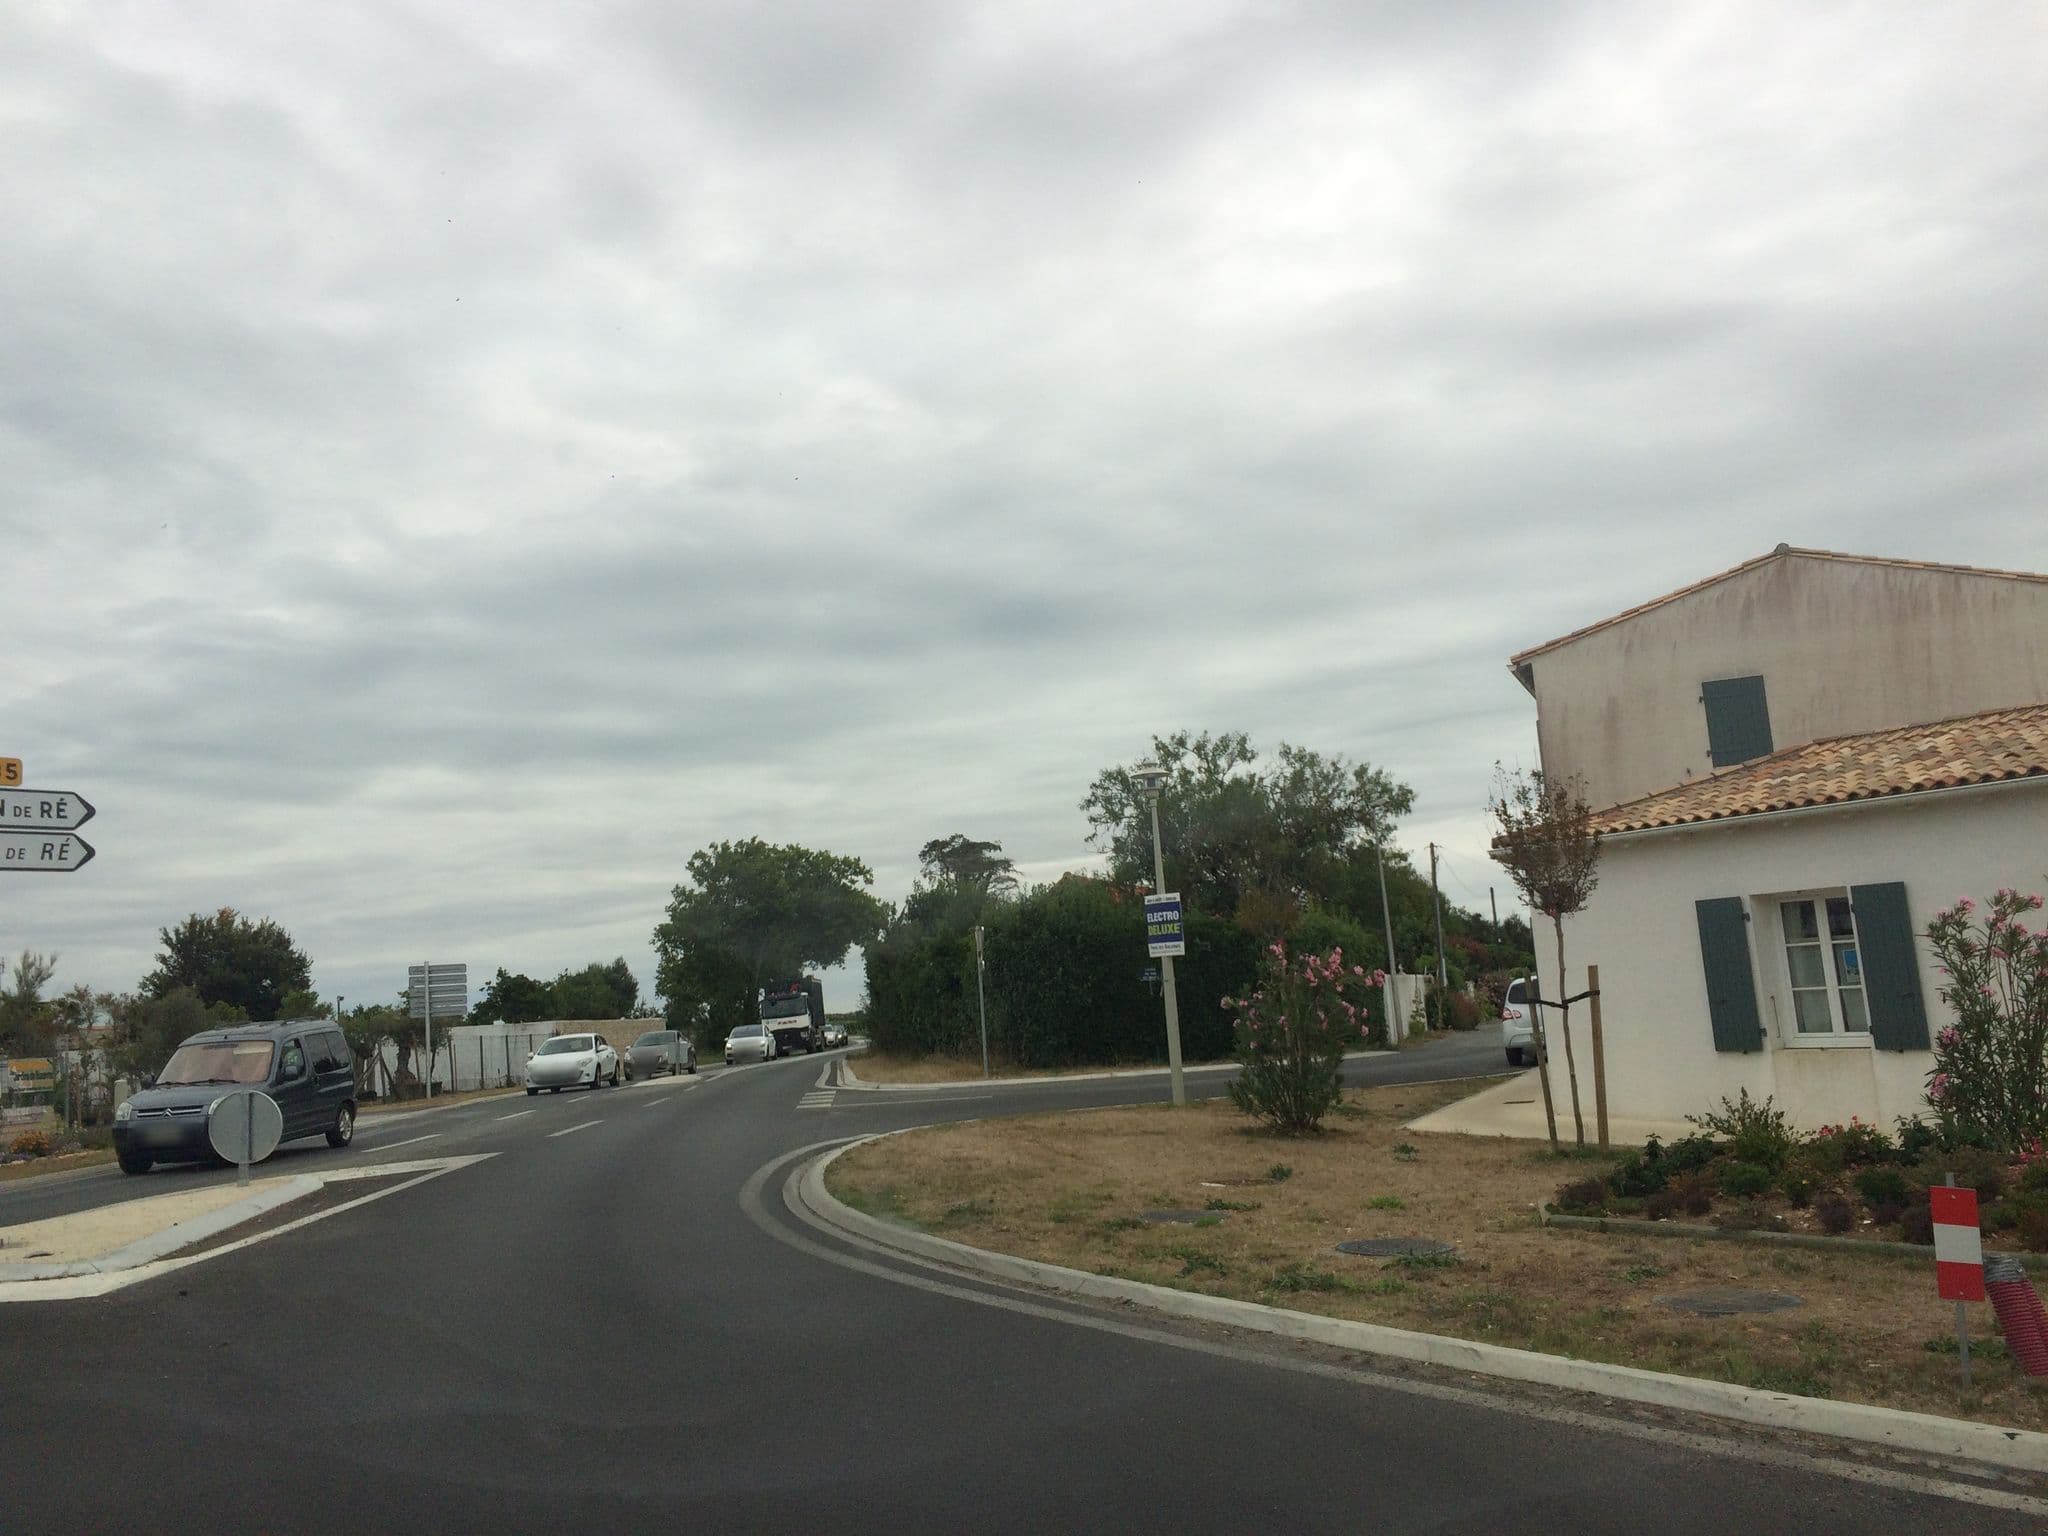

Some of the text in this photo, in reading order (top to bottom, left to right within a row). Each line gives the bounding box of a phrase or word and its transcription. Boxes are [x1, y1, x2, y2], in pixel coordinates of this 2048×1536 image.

[0, 763, 17, 781] 5
[13, 806, 31, 818] DE
[40, 798, 68, 819] RÉ
[6, 838, 70, 861] DE RÉ
[1147, 911, 1179, 922] ELECTRO
[1148, 923, 1180, 935] DELUXE
